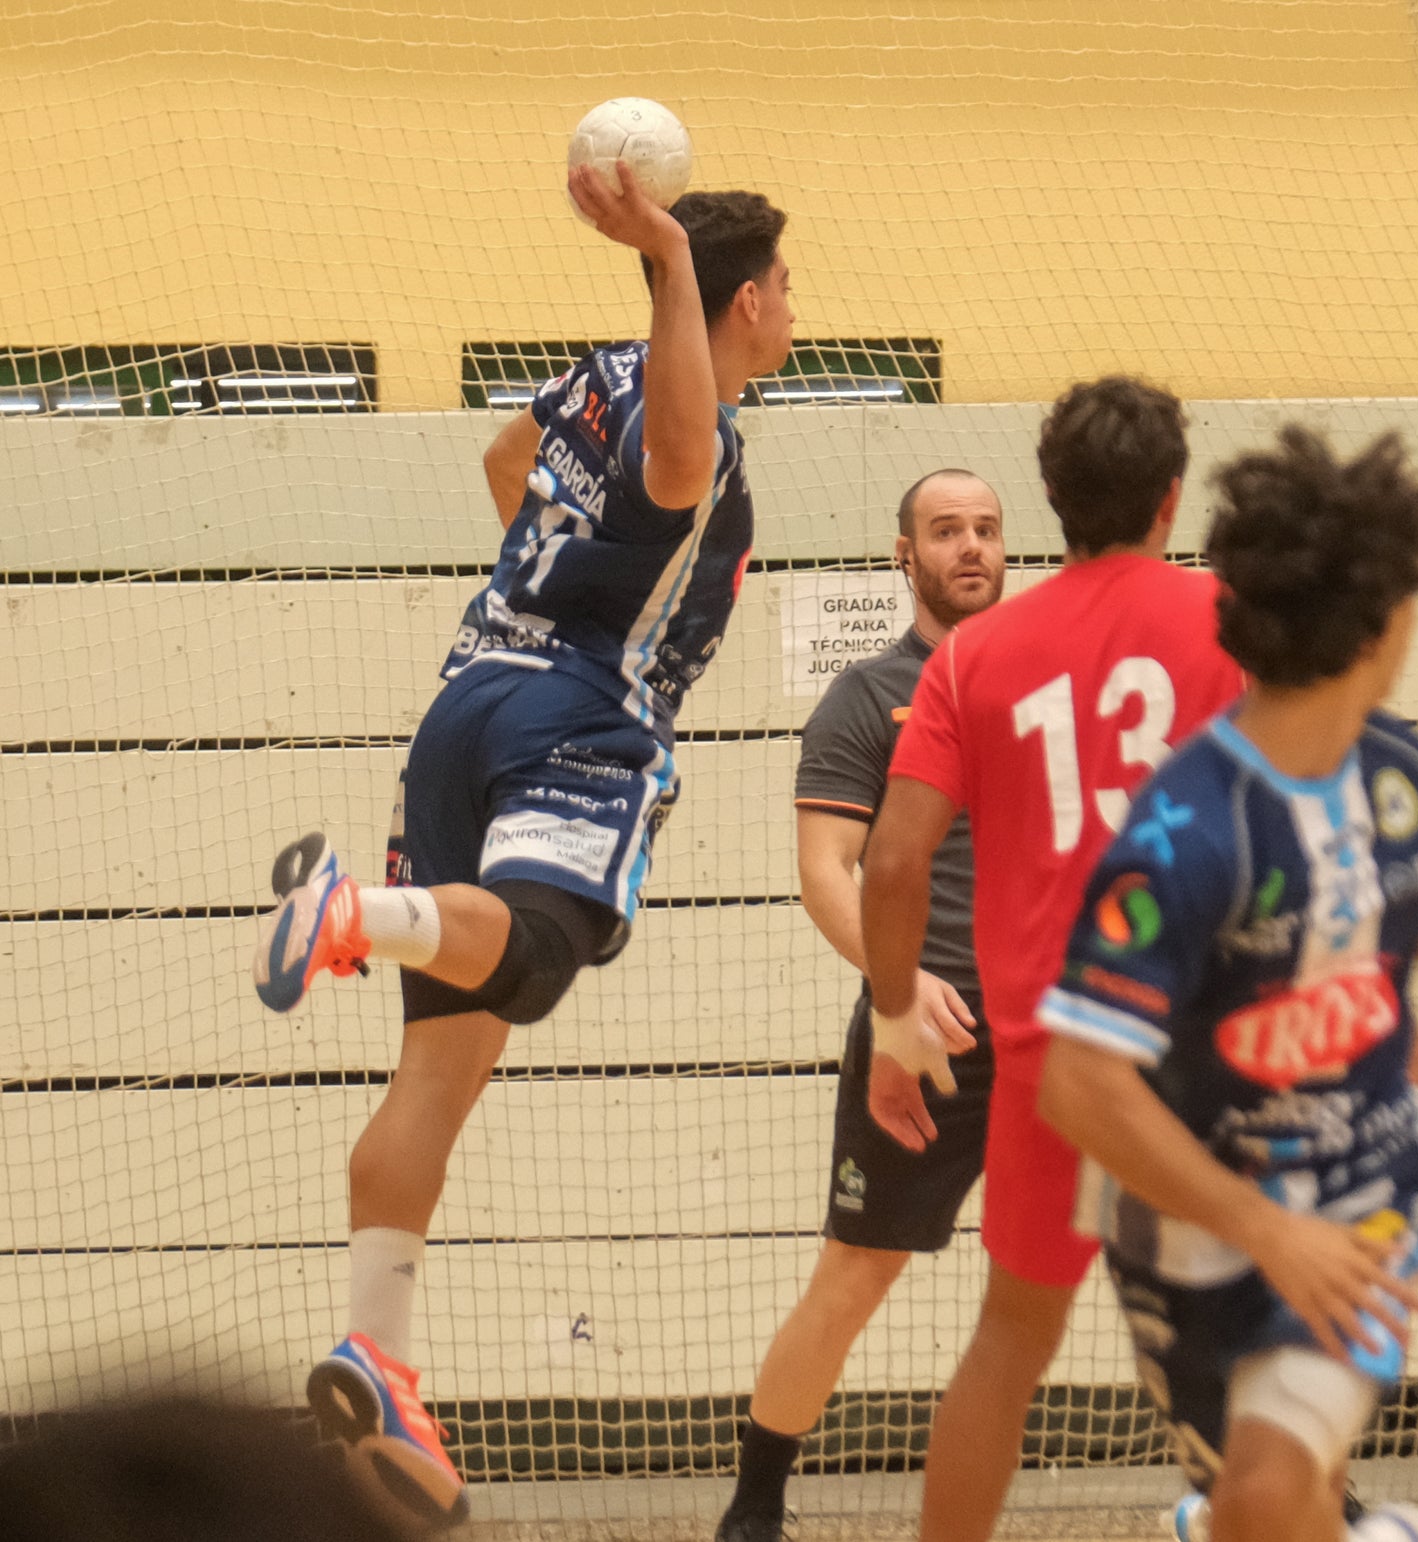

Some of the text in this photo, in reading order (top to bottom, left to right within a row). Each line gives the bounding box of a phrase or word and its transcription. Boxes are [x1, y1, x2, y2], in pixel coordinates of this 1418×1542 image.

[823, 597, 898, 613] GRADAS
[840, 619, 889, 633] PARA
[1012, 655, 1176, 854] 13
